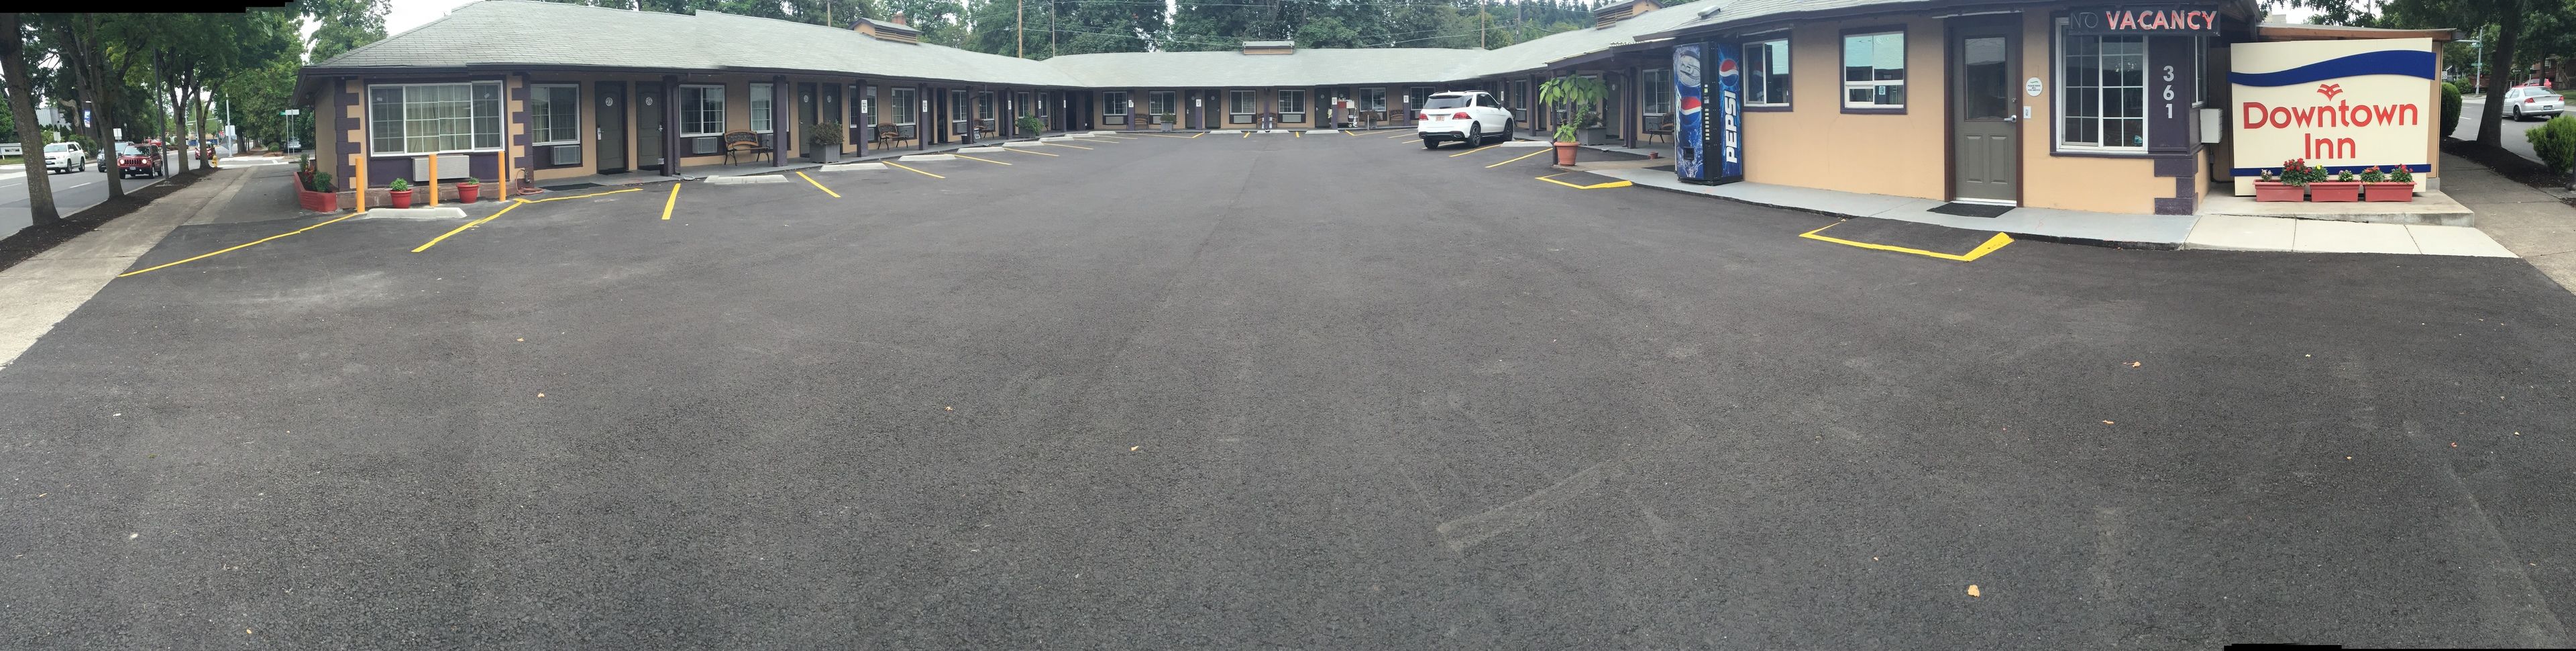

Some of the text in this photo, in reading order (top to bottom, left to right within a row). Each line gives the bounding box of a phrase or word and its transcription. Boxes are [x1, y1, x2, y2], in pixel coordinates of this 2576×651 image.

[2070, 10, 2218, 30] NO VACANCY
[2163, 65, 2175, 119] 361
[1724, 91, 1737, 164] PEPSI
[2243, 99, 2418, 129] Downtown
[2304, 133, 2356, 160] Inn
